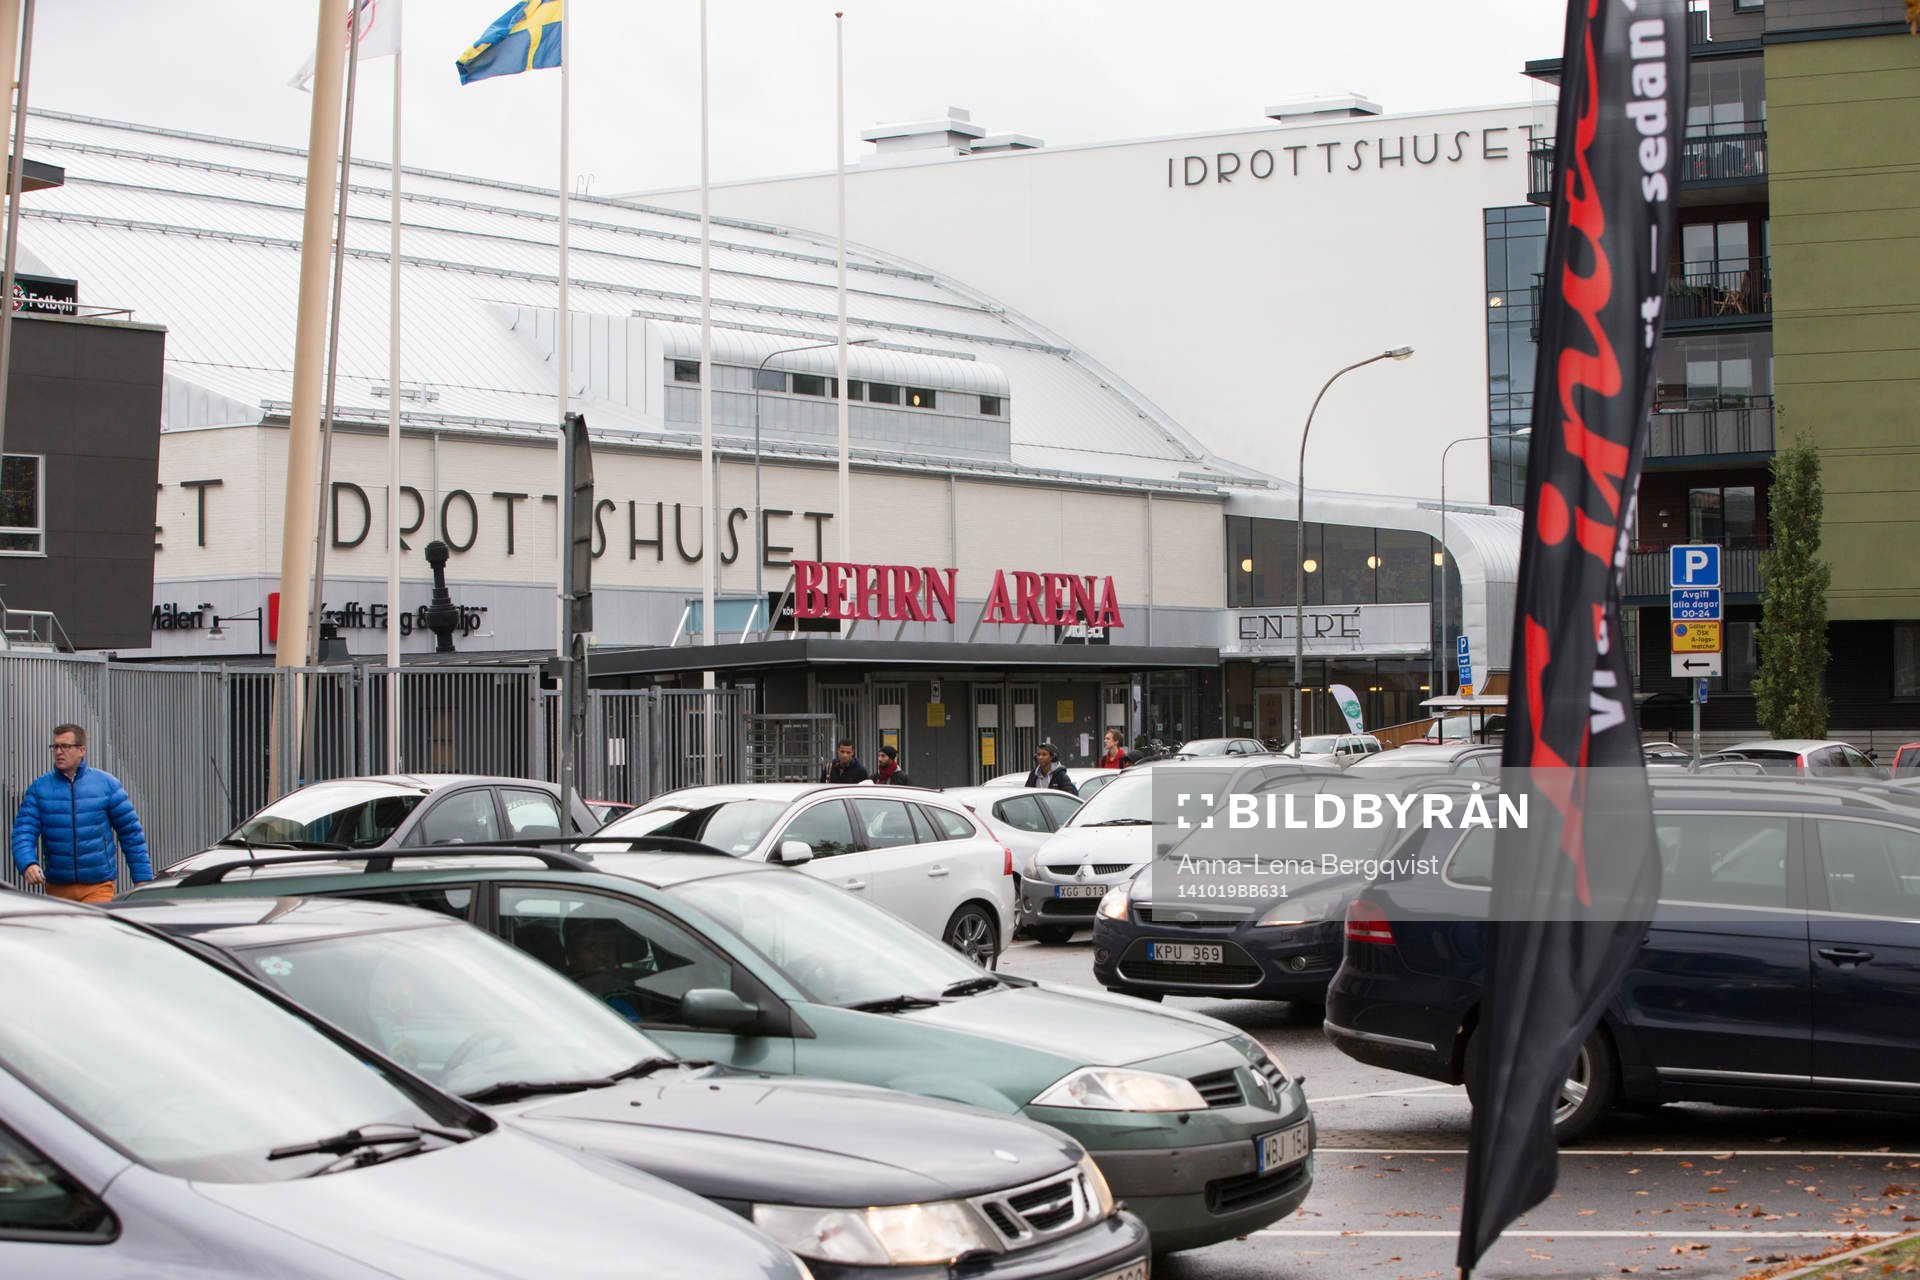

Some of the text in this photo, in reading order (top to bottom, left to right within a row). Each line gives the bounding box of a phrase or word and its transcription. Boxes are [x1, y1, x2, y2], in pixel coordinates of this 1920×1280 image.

[1625, 19, 1669, 203] sedan
[1169, 124, 1543, 187] IDROTTSHUSET
[29, 293, 73, 312] Fotboll
[1685, 550, 1708, 583] P
[791, 559, 1125, 628] BEHRN ARENA
[1681, 590, 1710, 600] Avgift
[1673, 601, 1719, 610] alla dagar
[1681, 610, 1710, 618] 00-24
[1461, 638, 1467, 653] P
[1060, 886, 1105, 897] XGG 013
[1155, 945, 1220, 961] KPU 969
[1265, 1135, 1285, 1167] WBJ
